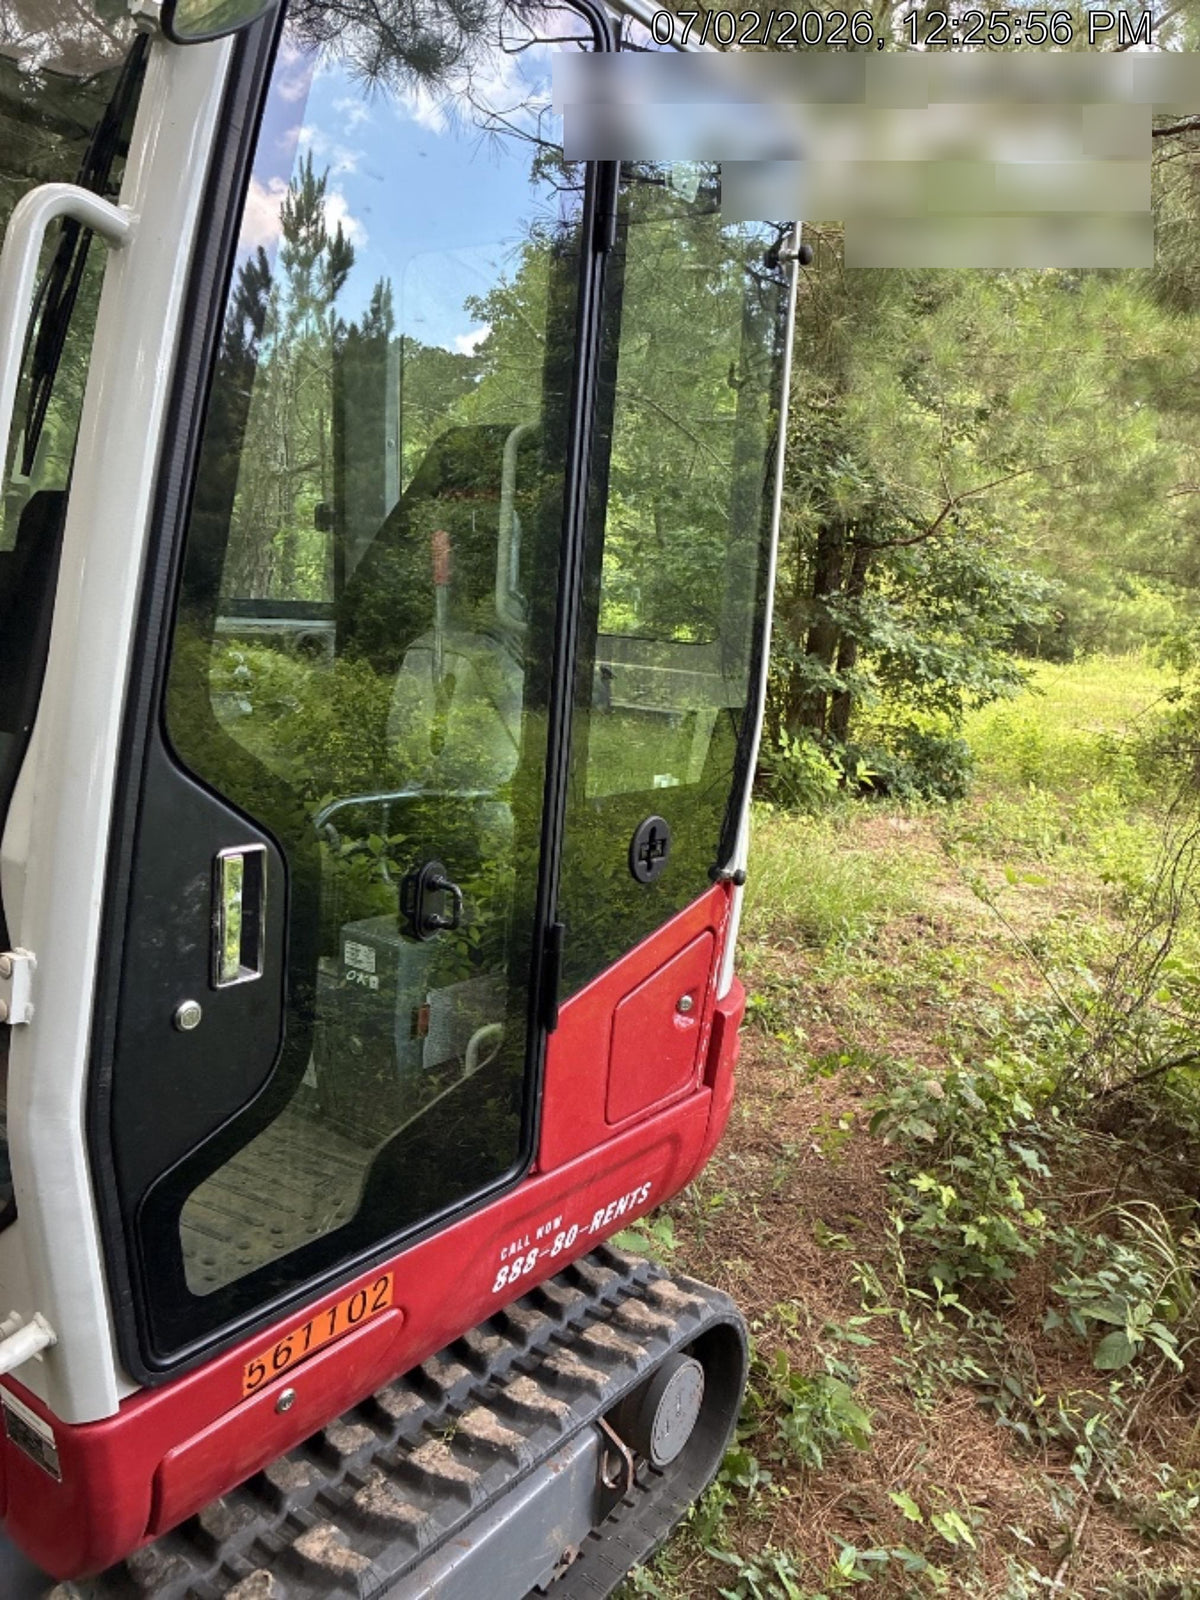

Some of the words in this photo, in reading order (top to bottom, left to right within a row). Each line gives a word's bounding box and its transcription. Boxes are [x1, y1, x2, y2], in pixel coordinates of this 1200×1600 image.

[492, 1181, 652, 1294] 888-80-RENTS
[500, 1235, 530, 1262] CALL
[536, 1215, 563, 1240] NOW
[246, 1276, 390, 1390] 561102
